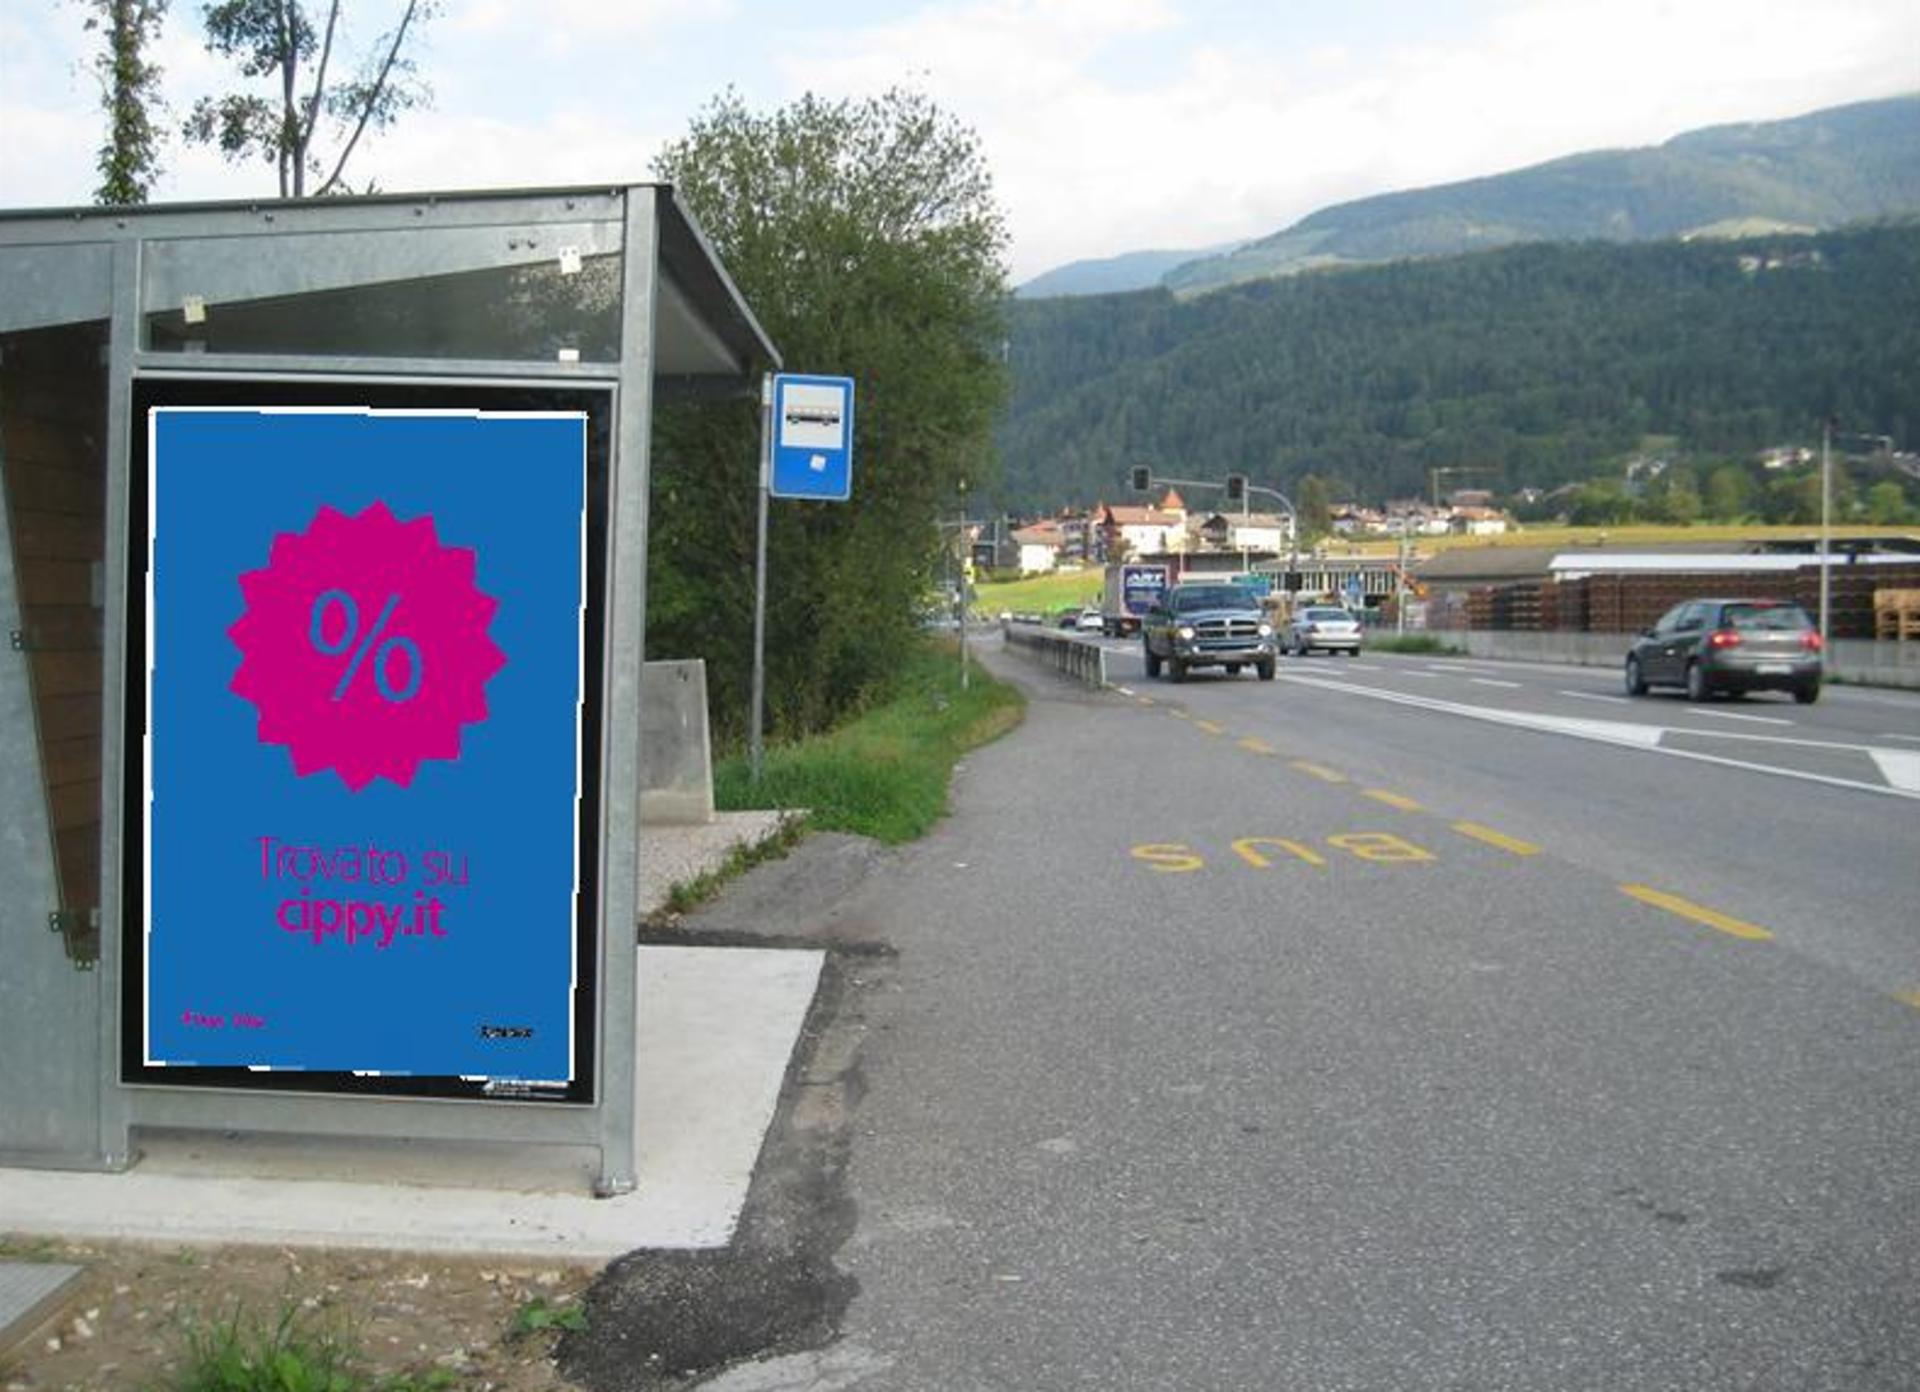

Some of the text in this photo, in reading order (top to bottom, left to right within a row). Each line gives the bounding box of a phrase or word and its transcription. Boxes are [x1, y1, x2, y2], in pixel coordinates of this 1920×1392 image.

[309, 588, 423, 702] %
[257, 836, 469, 886] Trovato su
[1130, 833, 1437, 872] BUS
[276, 887, 448, 950] cippy.it
